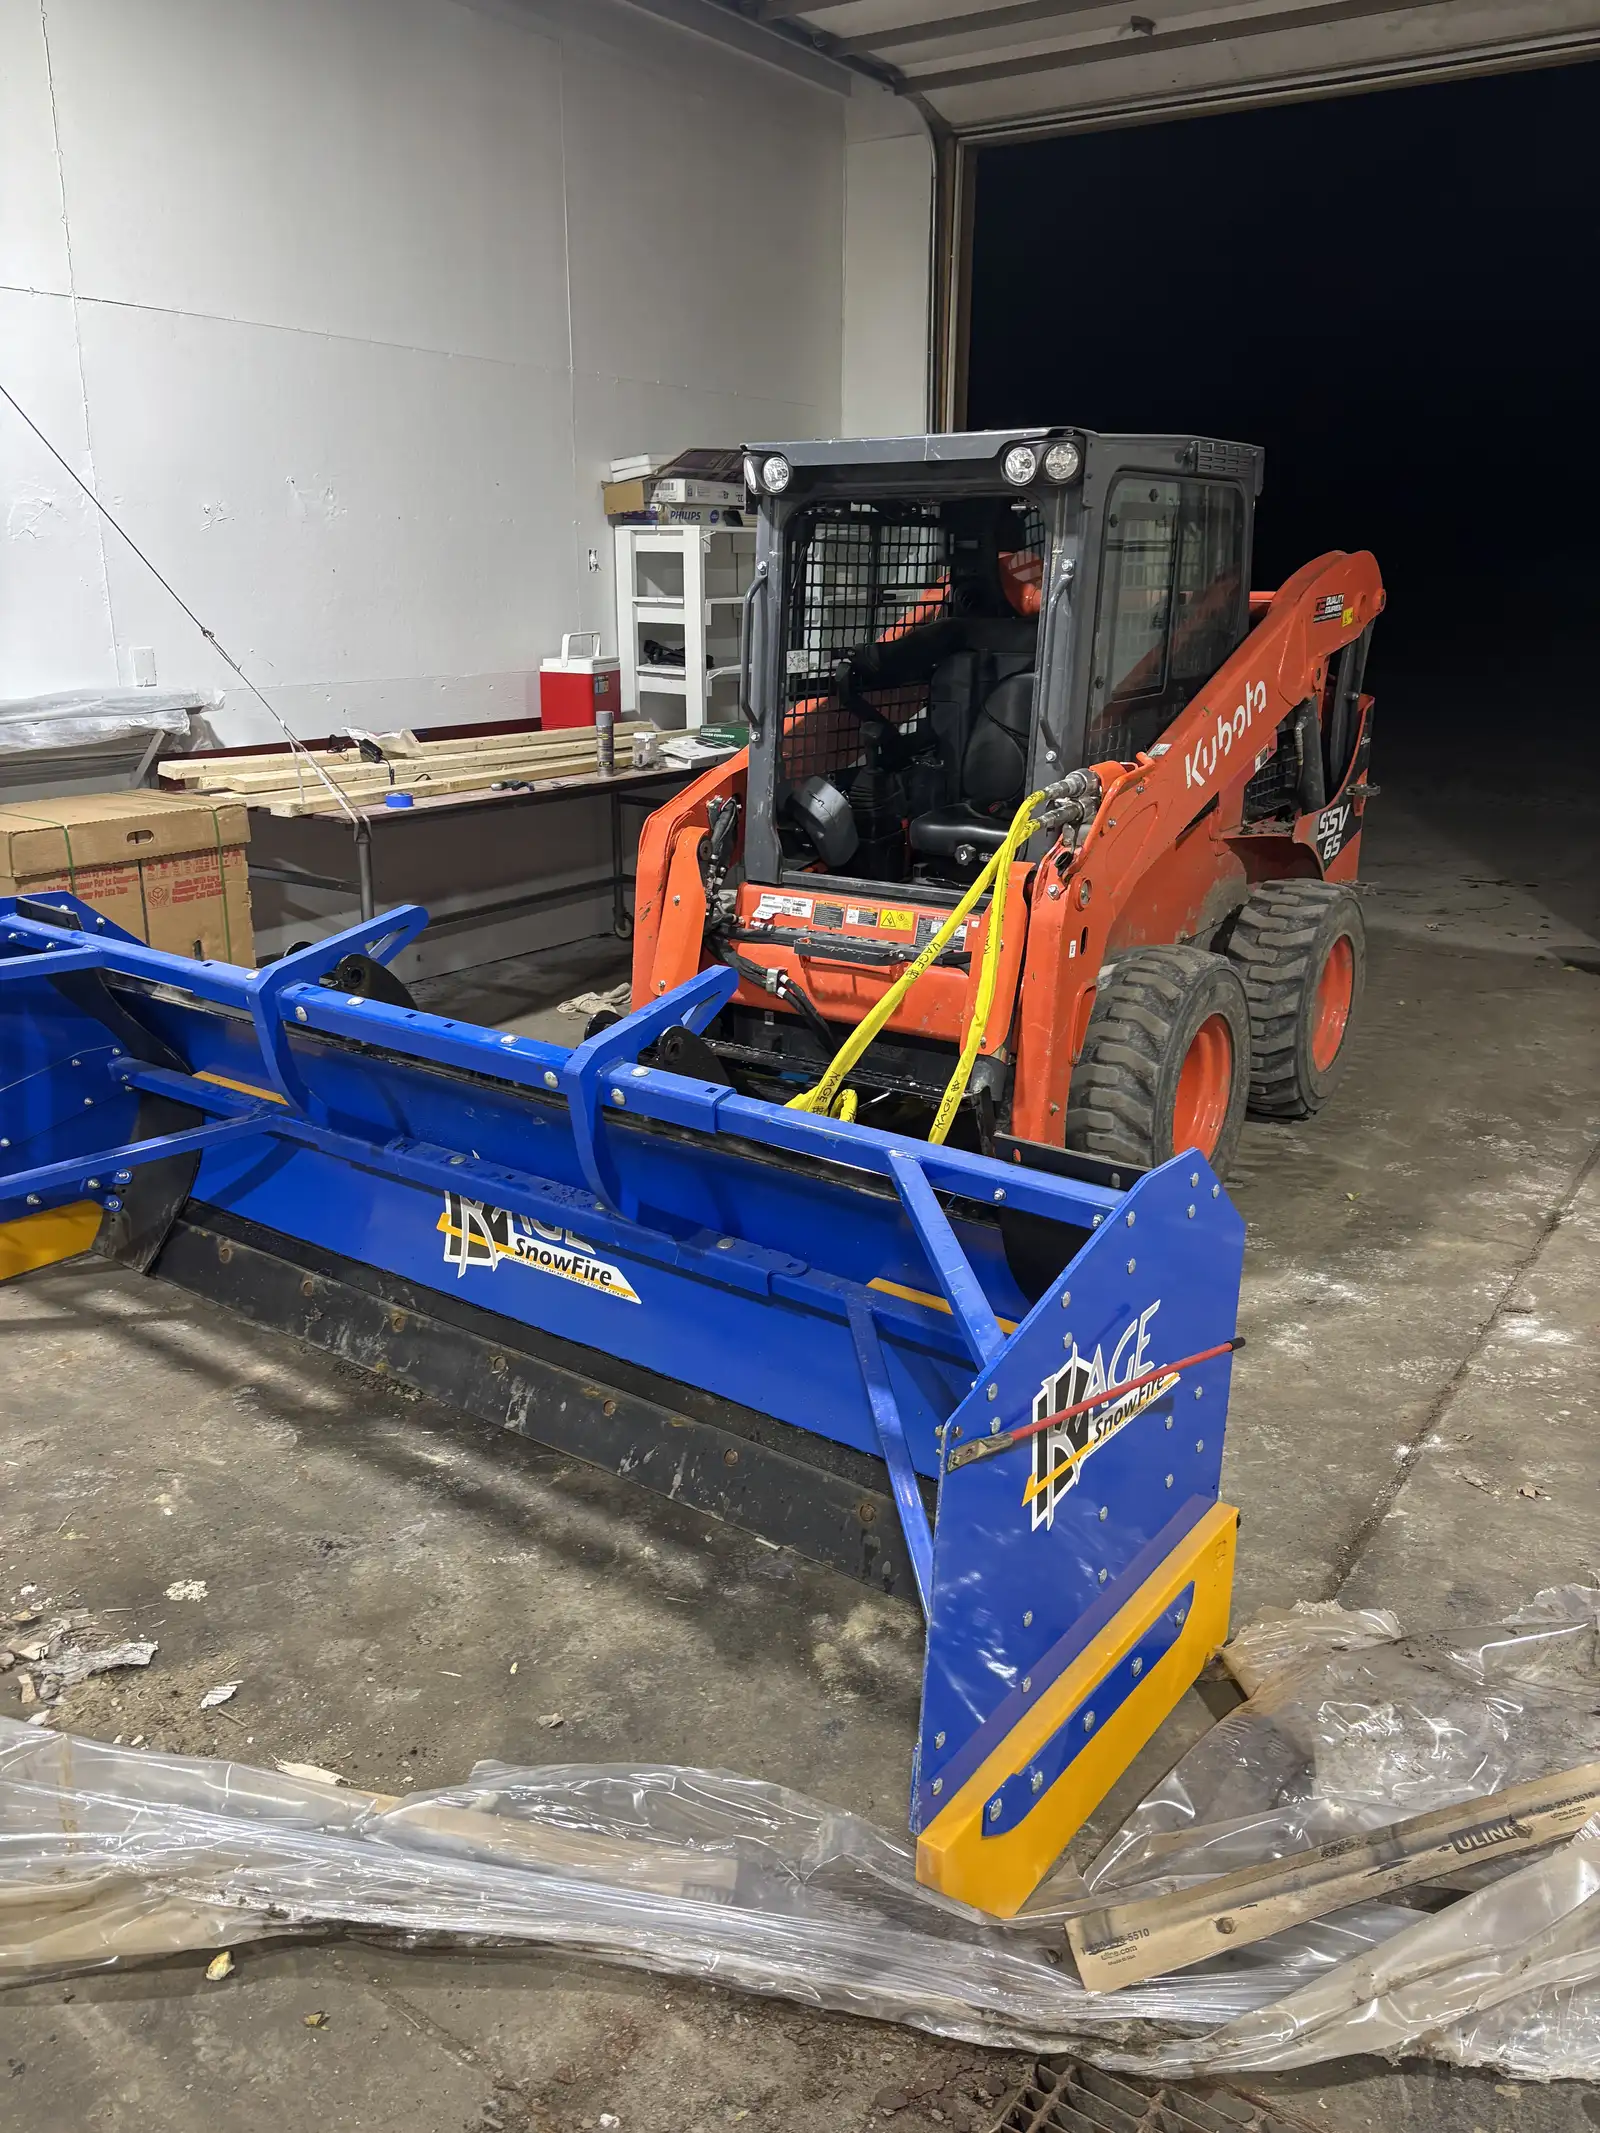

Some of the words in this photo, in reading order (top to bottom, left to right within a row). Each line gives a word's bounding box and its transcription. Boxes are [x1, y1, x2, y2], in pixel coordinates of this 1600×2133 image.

[670, 510, 702, 521] PHILIPS
[1325, 594, 1345, 606] QUALITY
[1184, 680, 1267, 789] Kubota
[1317, 803, 1351, 841] SSV
[1323, 833, 1342, 861] 65
[914, 942, 941, 969] KAGE
[817, 1071, 841, 1103] KAGE
[514, 1237, 612, 1286] SnowFire
